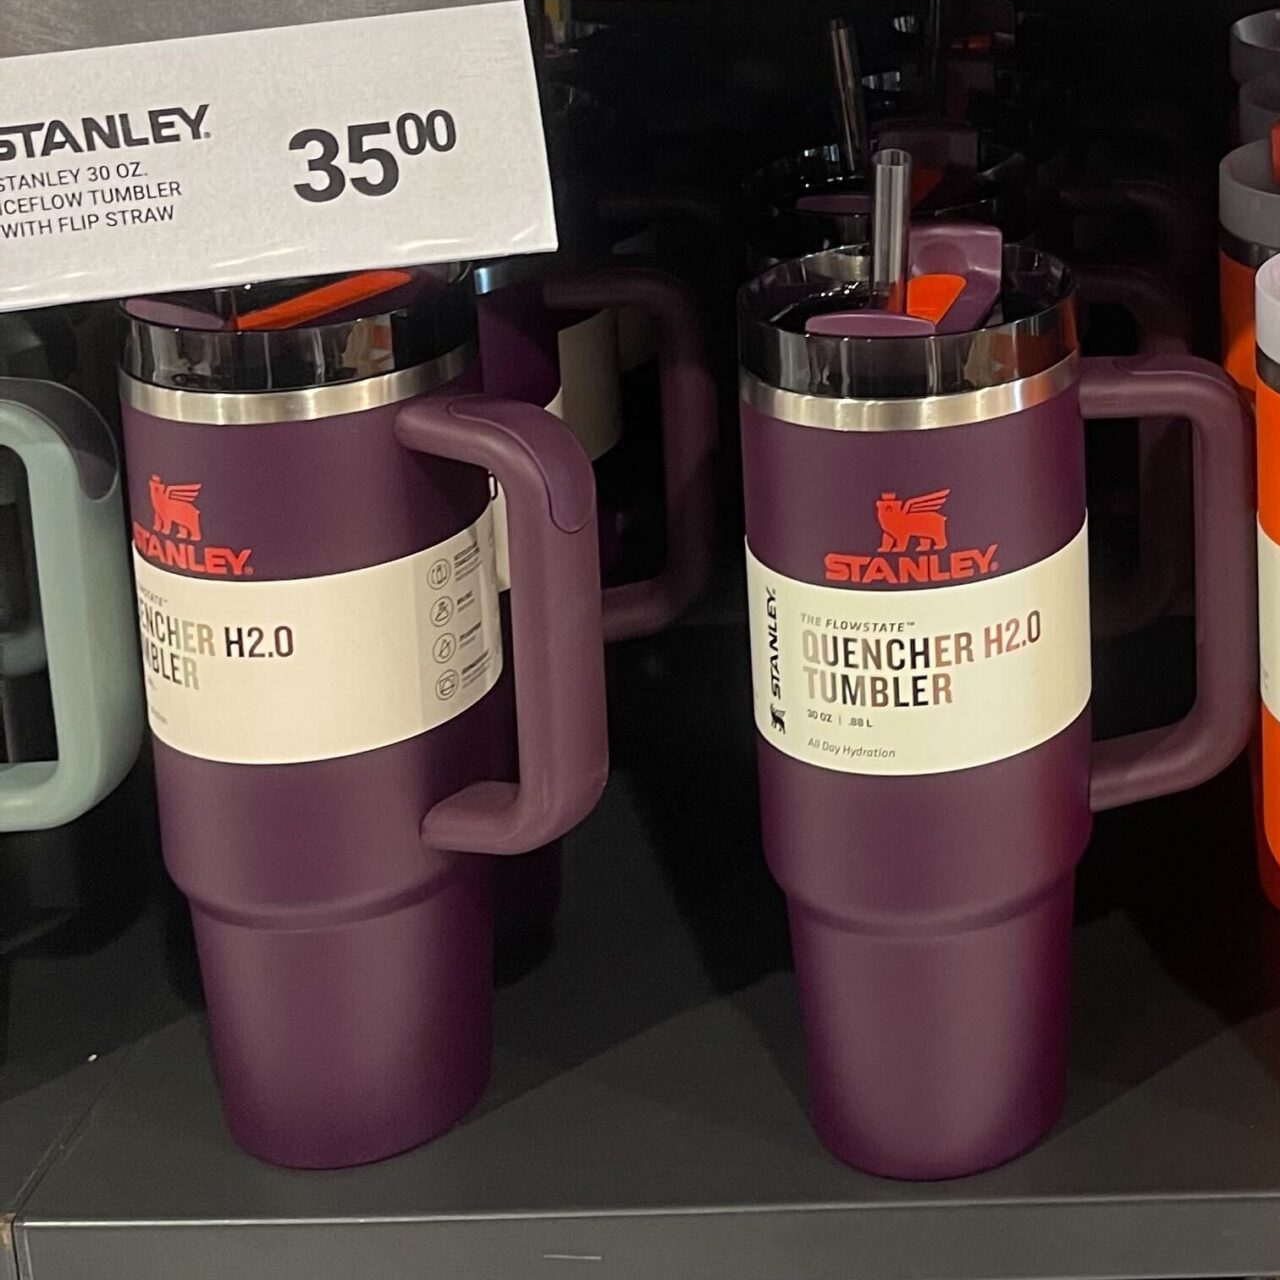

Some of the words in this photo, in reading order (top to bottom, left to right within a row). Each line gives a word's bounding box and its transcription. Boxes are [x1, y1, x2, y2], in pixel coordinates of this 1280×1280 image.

[87, 165, 110, 182] 30
[116, 161, 148, 179] OZ.
[87, 180, 182, 206] TUMBLER
[1, 219, 53, 239] WITH
[58, 213, 99, 233] FLIP
[105, 205, 174, 227] STRAW
[801, 613, 821, 627] THE
[224, 625, 294, 660] H2.0
[802, 629, 974, 671] QUENCHER
[984, 609, 1041, 659] H2.0
[802, 665, 953, 708] TUMBLER
[820, 712, 832, 723] OZ
[866, 719, 873, 728] L
[808, 738, 820, 749] All
[822, 740, 840, 756] Day
[842, 745, 896, 758] Hydration
